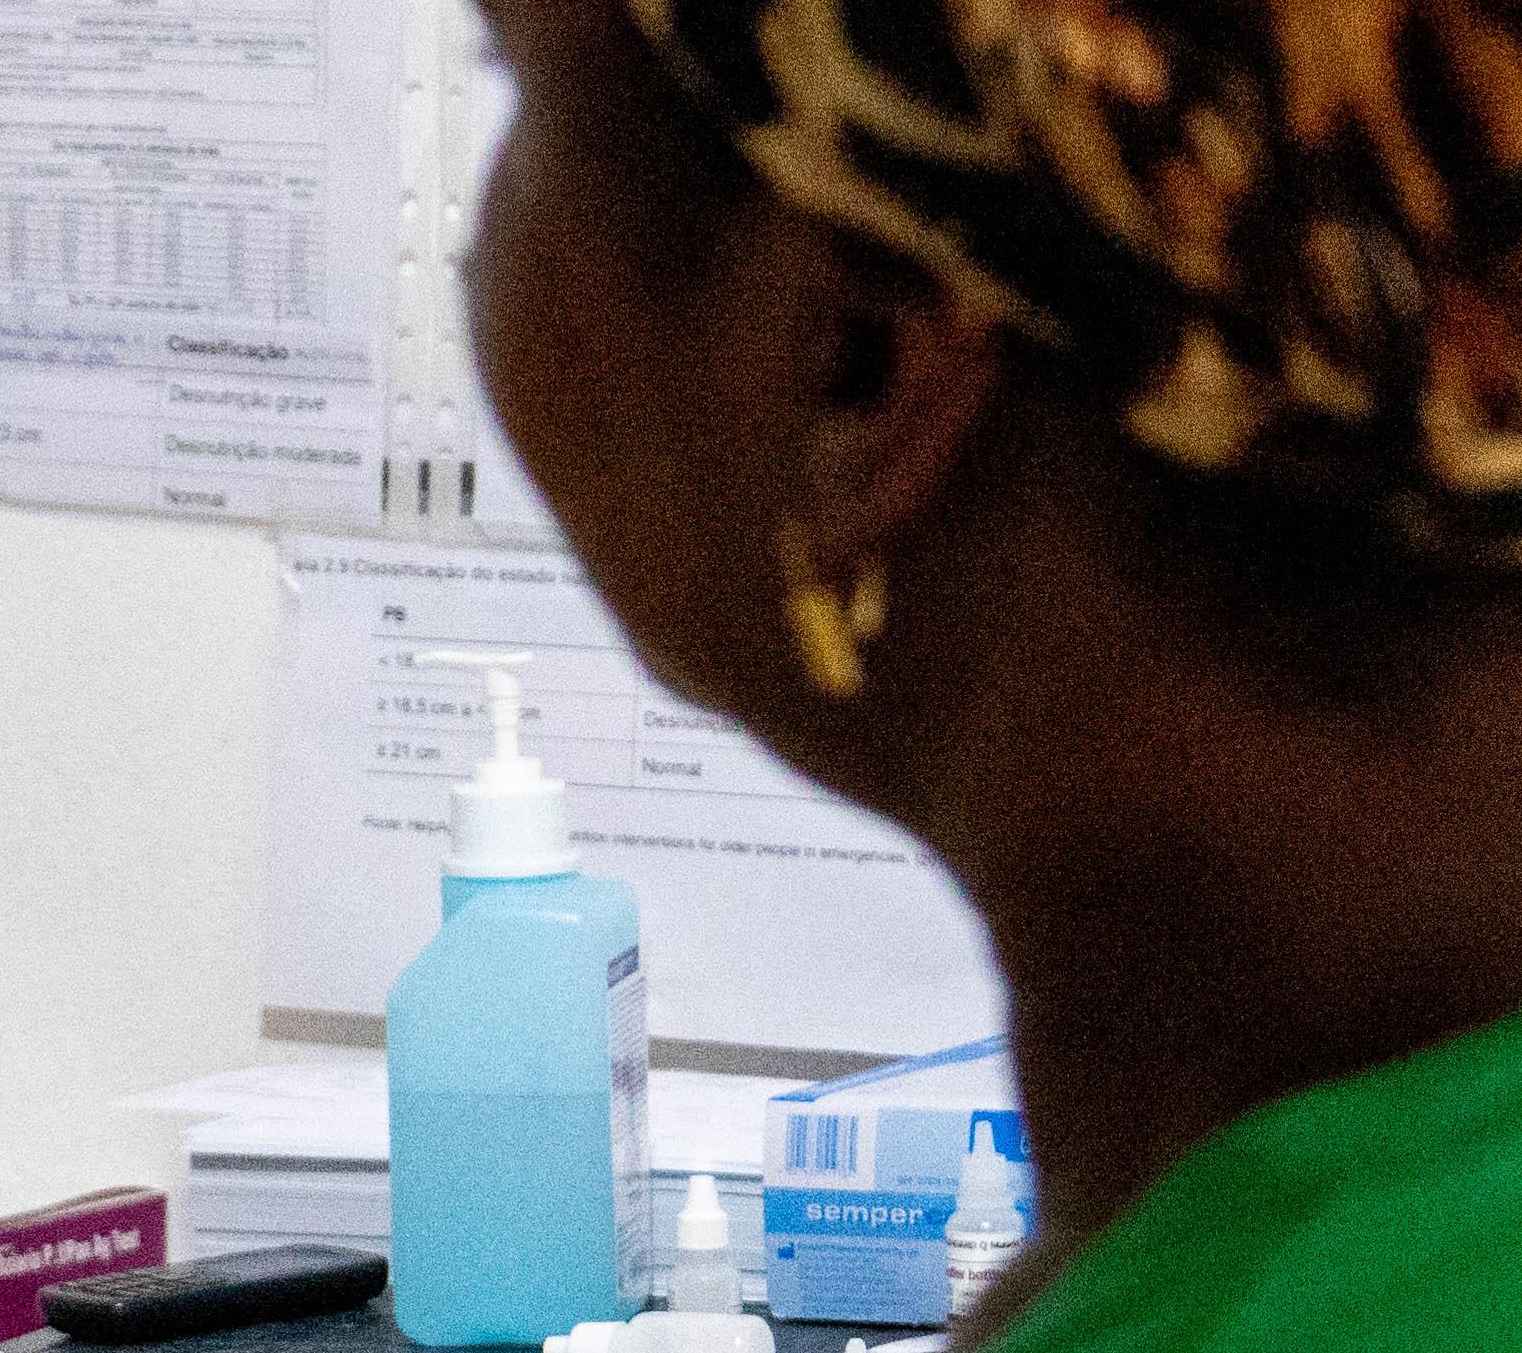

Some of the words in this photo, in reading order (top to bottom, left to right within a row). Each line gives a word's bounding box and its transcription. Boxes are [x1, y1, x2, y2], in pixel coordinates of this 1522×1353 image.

[167, 334, 289, 362] Classificação
[170, 384, 271, 410] Desnutrição
[276, 395, 326, 413] grave
[165, 433, 269, 461] Desnutrição
[273, 446, 362, 466] moderada
[164, 488, 226, 507] Normal
[353, 557, 465, 582] Classificação
[471, 564, 493, 581] do
[499, 567, 555, 584] estado
[382, 604, 406, 623] PB
[642, 759, 702, 777] Normal
[806, 1202, 923, 1228] semper
